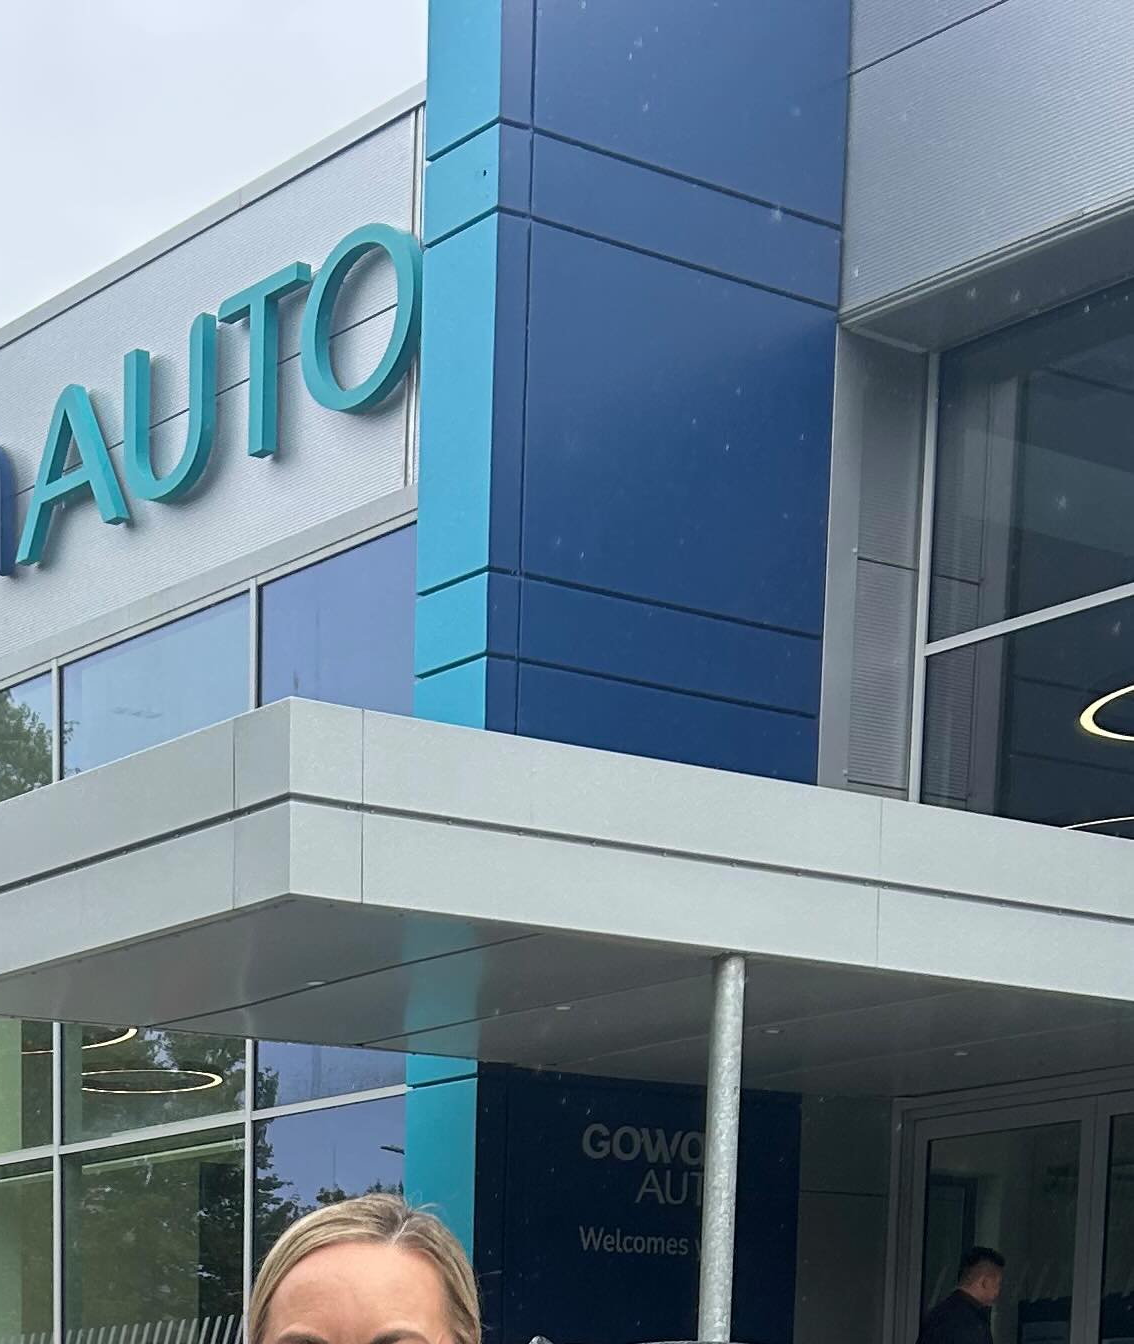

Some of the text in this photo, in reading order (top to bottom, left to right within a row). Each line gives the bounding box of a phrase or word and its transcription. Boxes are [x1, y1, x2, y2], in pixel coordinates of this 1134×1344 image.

[16, 222, 423, 566] AUTO
[634, 1168, 704, 1206] AUT
[578, 1225, 689, 1256] Welcomes
